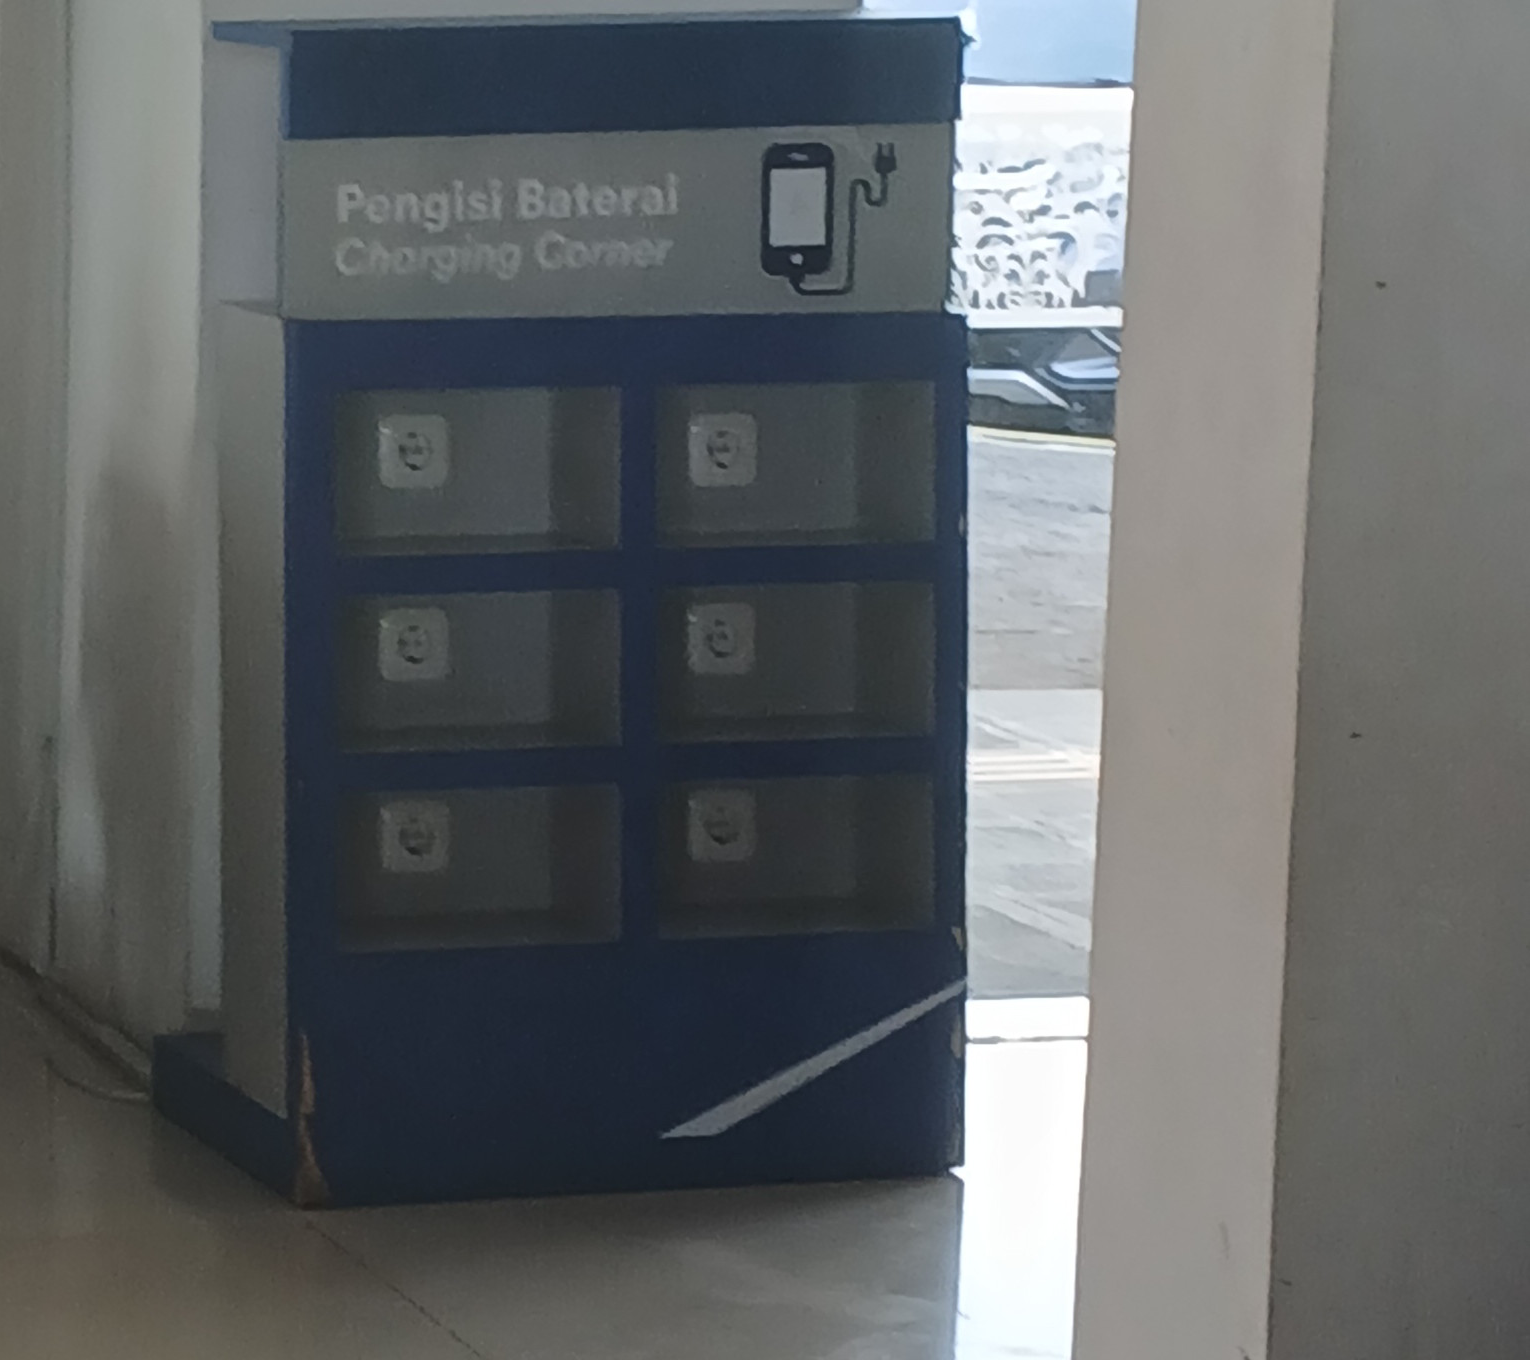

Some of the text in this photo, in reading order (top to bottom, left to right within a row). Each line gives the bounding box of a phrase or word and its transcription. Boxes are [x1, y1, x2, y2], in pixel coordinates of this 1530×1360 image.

[336, 172, 679, 233] Pengisi Baterai
[335, 230, 674, 282] Charging Corner
